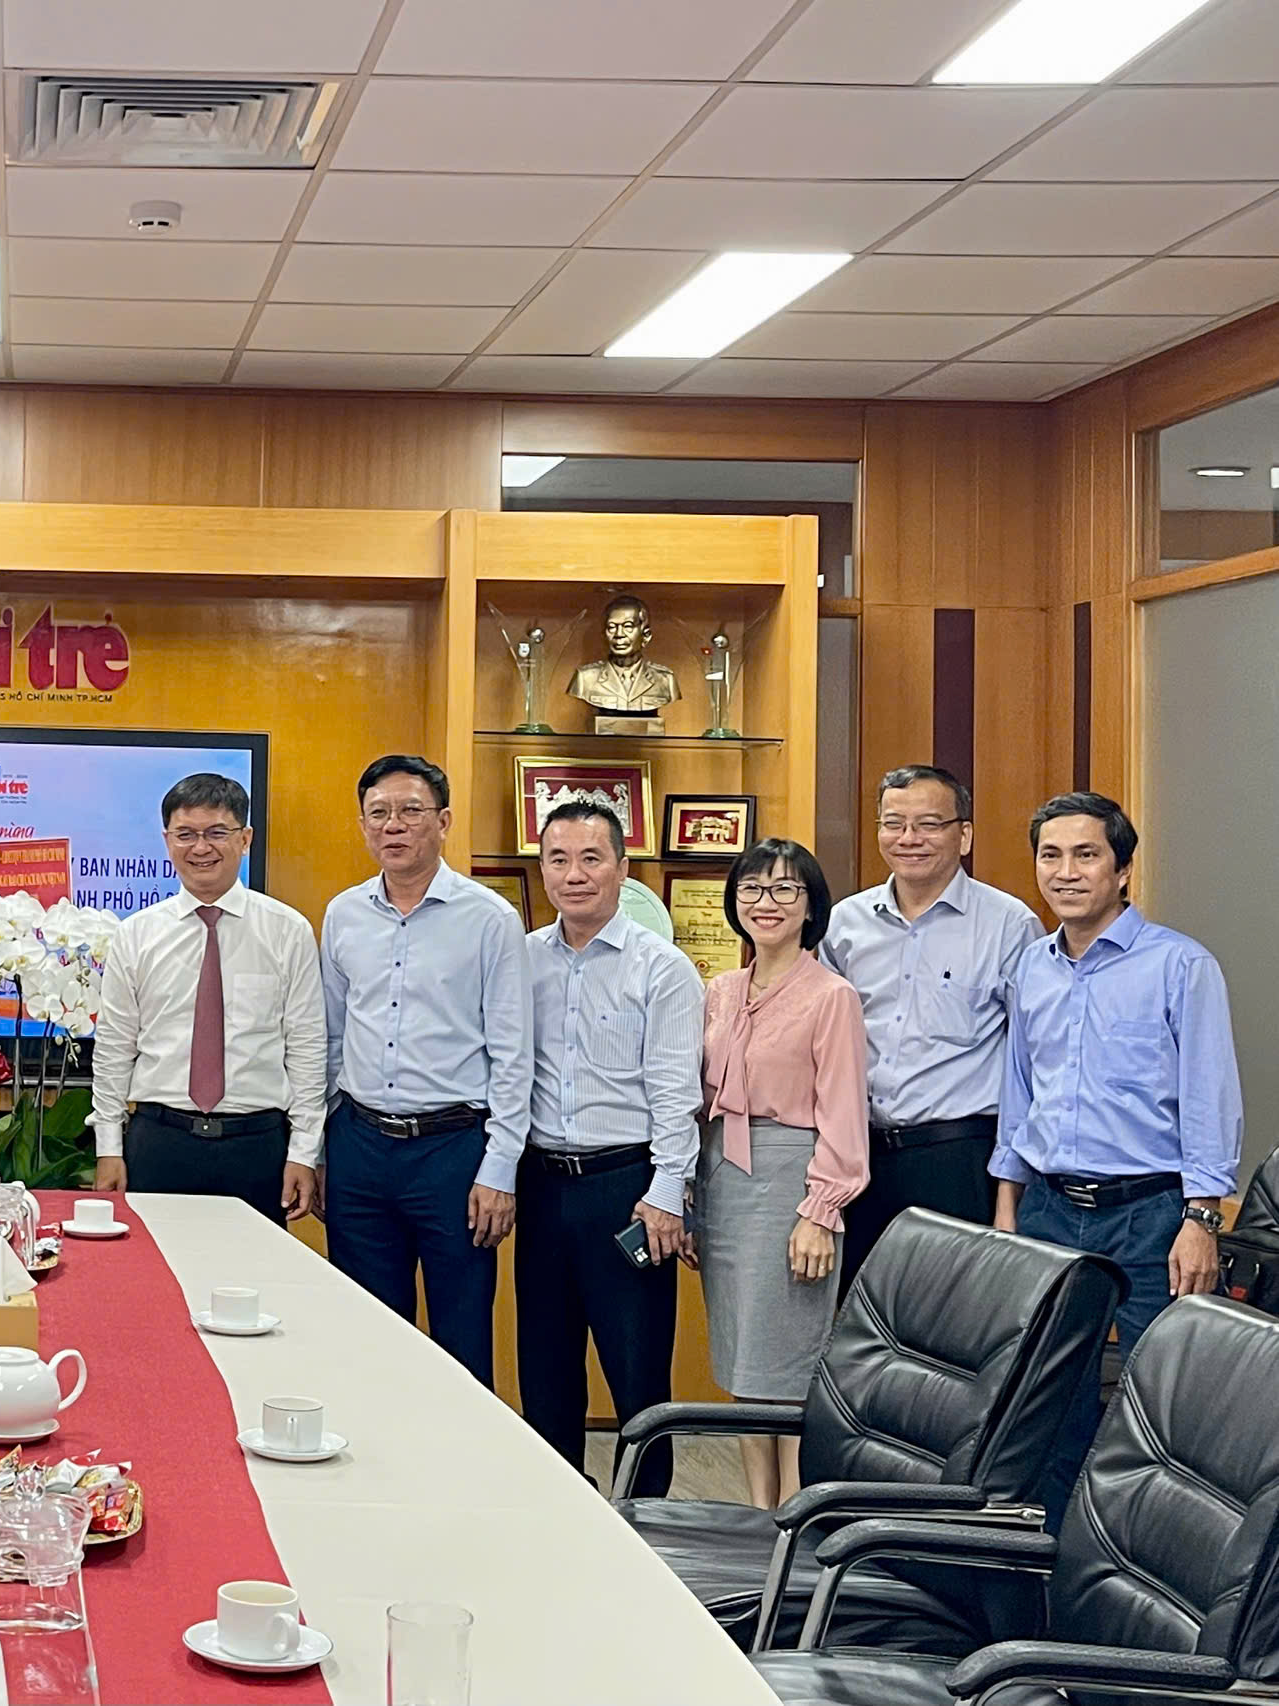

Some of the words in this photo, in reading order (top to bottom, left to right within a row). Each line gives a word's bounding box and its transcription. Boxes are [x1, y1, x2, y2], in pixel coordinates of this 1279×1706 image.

[18, 604, 130, 692] trẻ
[26, 692, 44, 701] CHÍ
[47, 693, 73, 702] MINH
[80, 857, 110, 877] BAN
[115, 854, 157, 878] NHÂN
[103, 882, 134, 910] PHỐ
